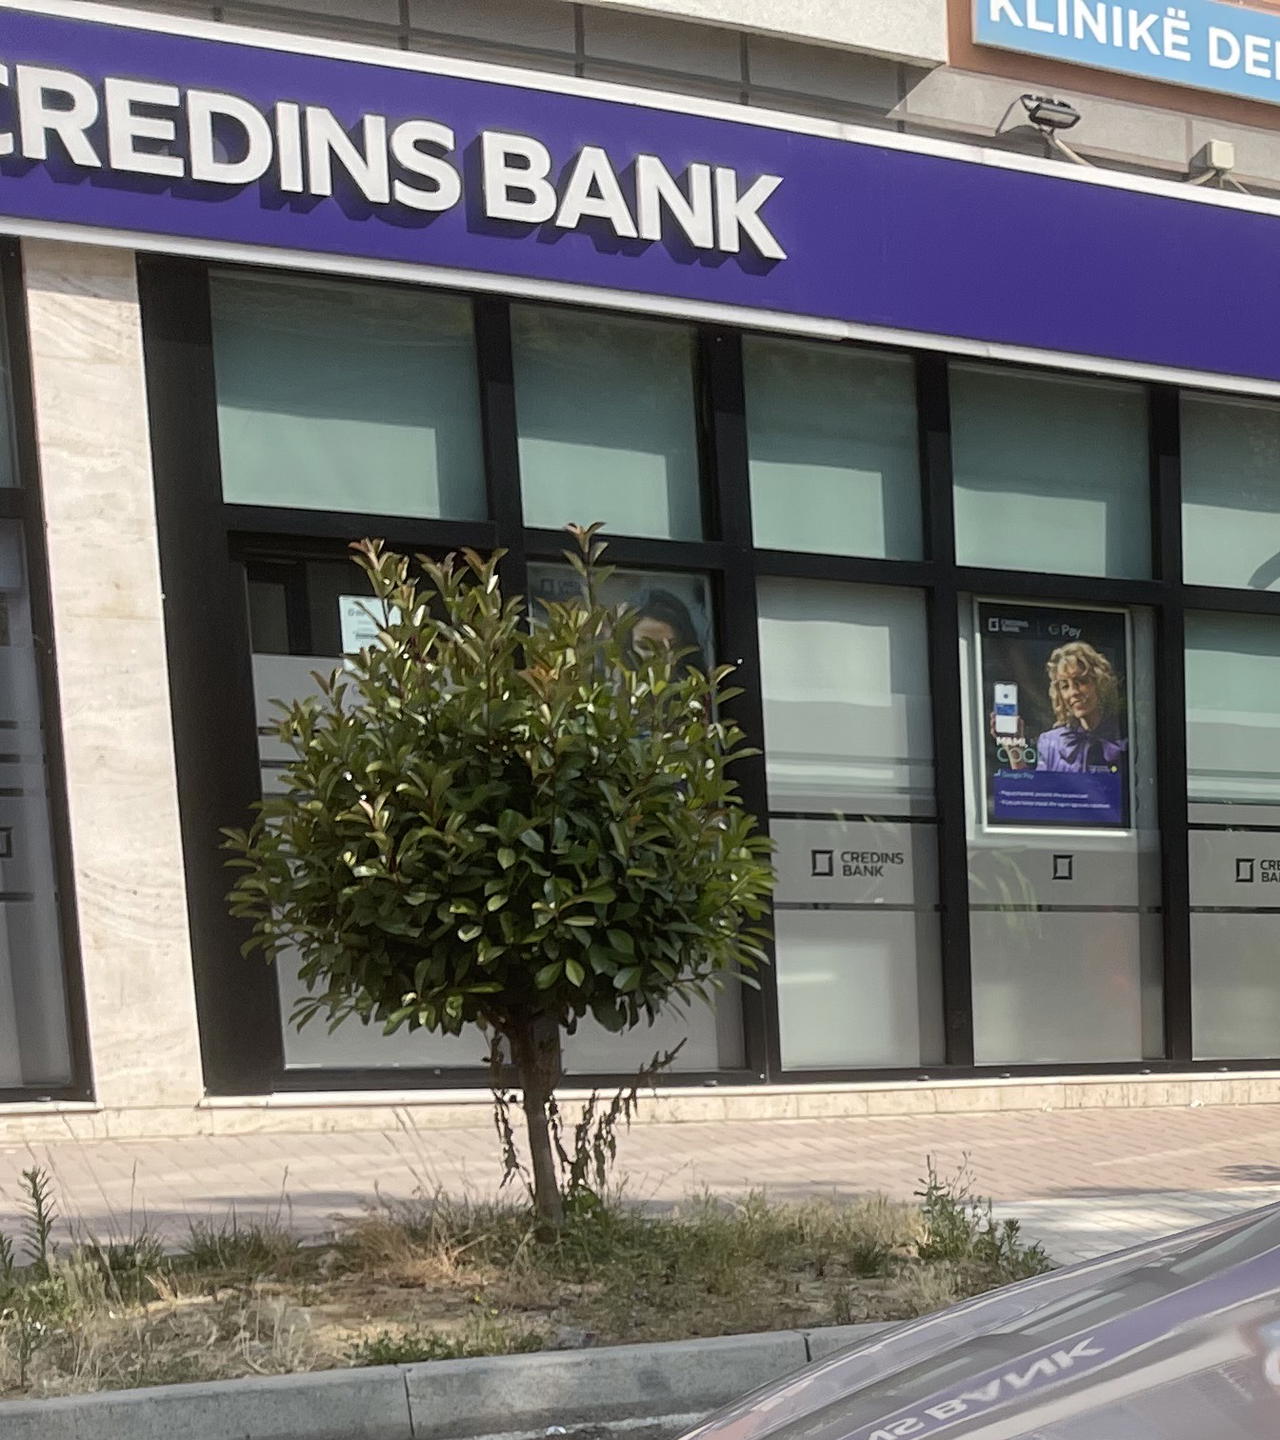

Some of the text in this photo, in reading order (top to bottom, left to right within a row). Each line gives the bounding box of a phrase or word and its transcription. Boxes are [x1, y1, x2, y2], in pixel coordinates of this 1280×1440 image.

[0, 63, 787, 260] REDINS BANK
[1061, 624, 1082, 639] Pay
[841, 851, 904, 865] CREDINS
[842, 865, 884, 877] BANK
